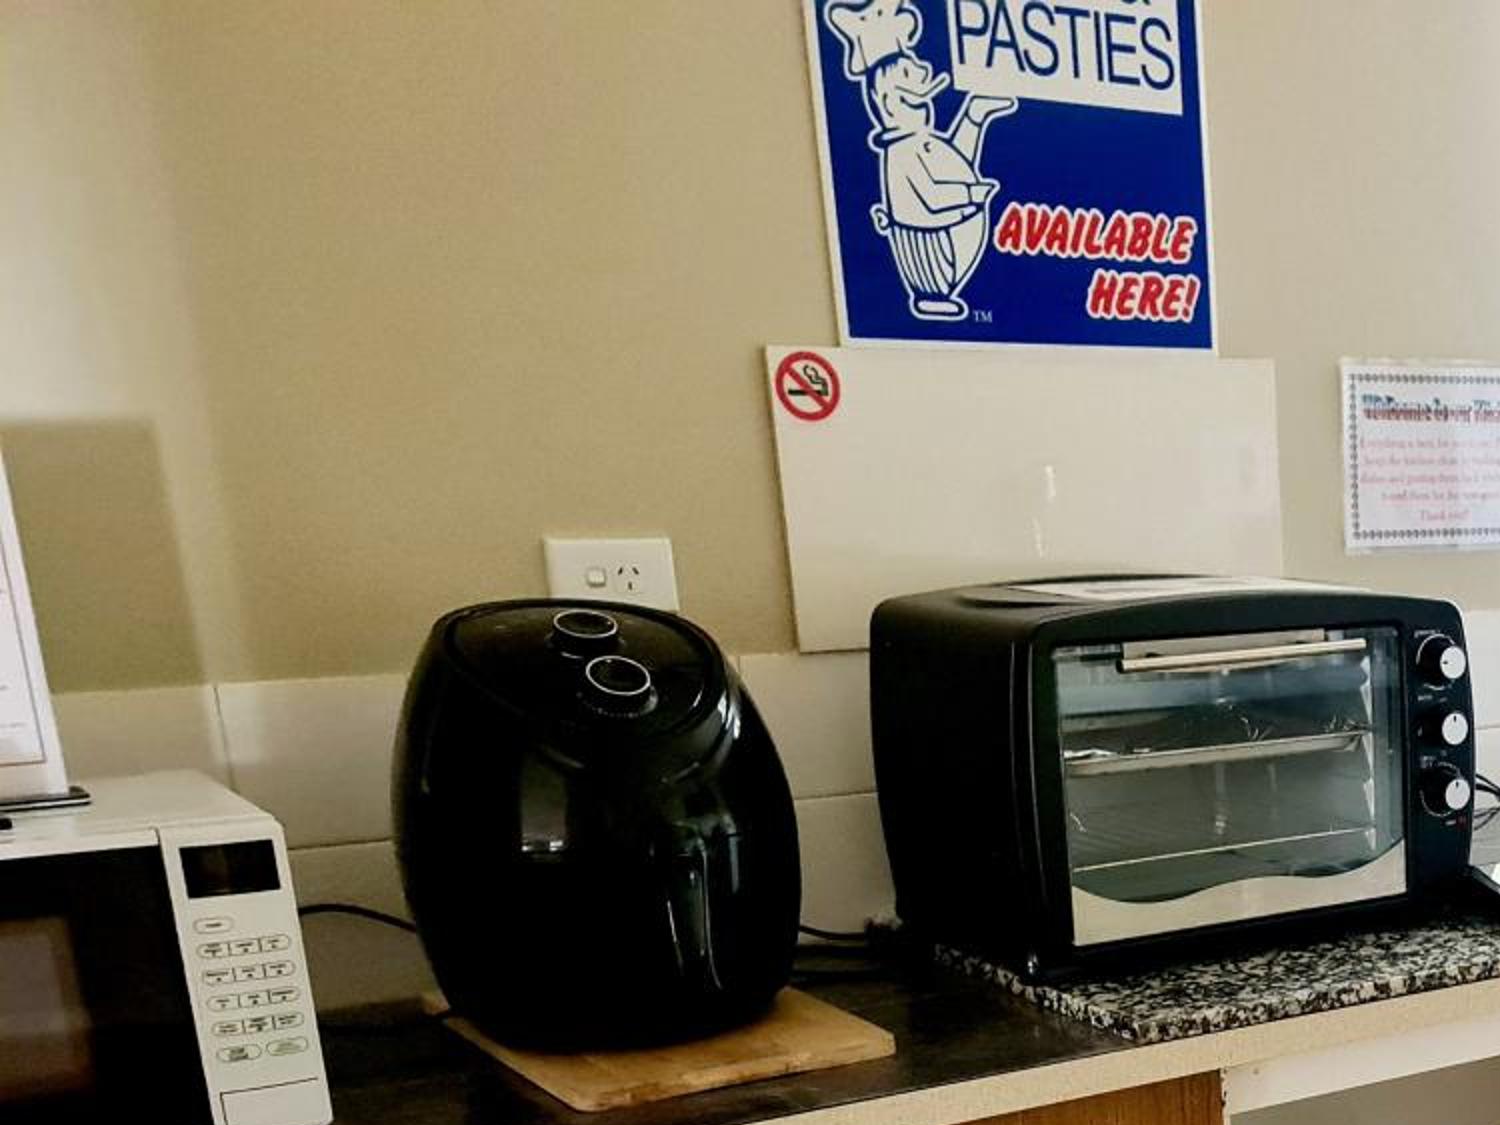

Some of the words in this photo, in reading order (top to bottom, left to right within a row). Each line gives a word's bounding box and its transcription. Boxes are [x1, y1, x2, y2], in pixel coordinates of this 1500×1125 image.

[955, 1, 1175, 91] PASTIES
[995, 203, 1197, 263] AVAILABLE
[1087, 271, 1199, 322] HERE!
